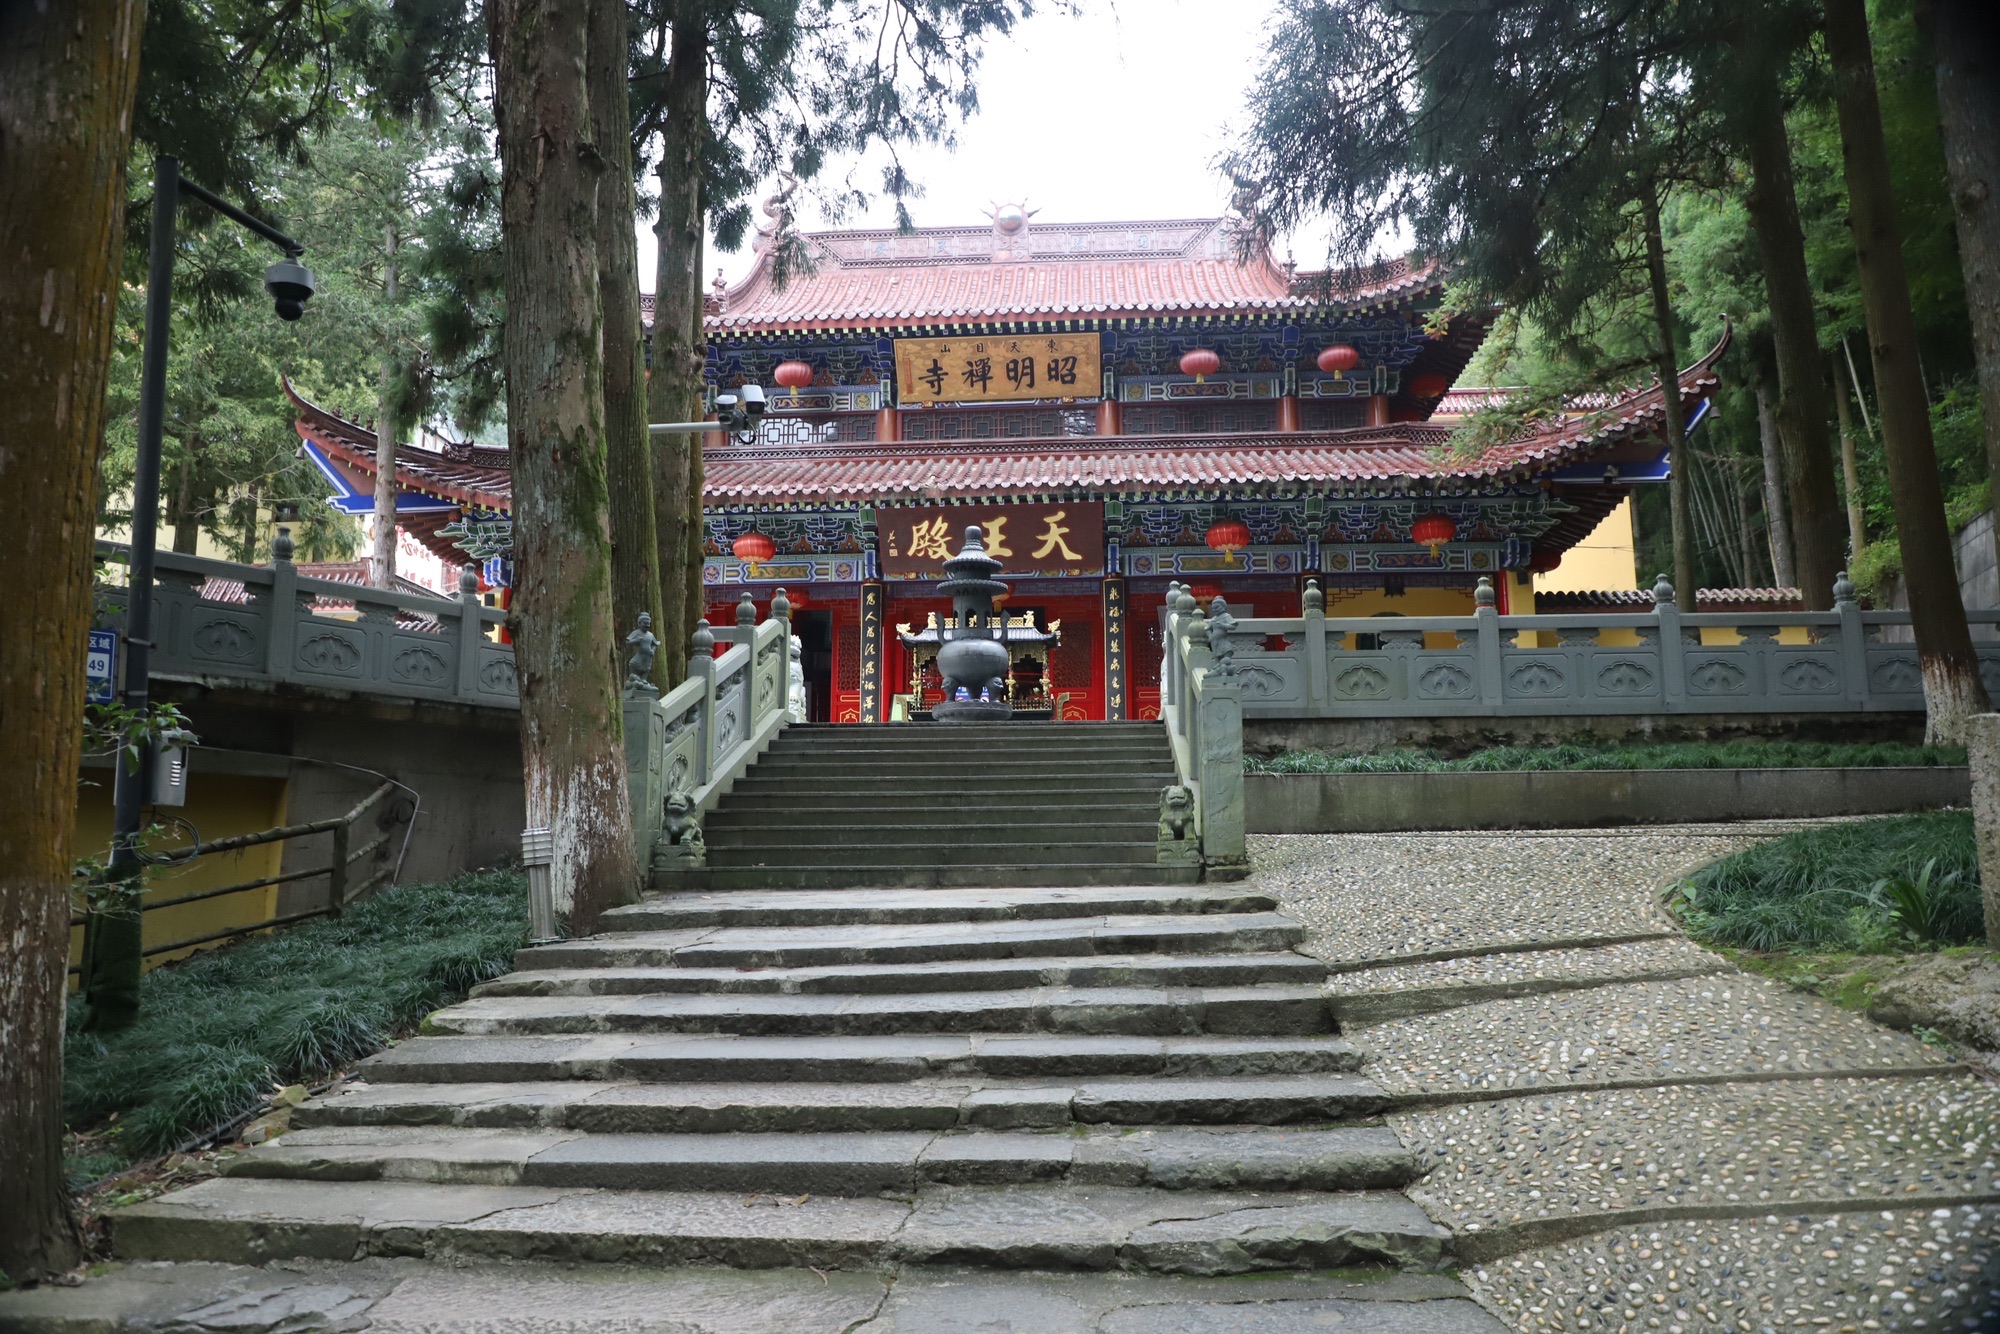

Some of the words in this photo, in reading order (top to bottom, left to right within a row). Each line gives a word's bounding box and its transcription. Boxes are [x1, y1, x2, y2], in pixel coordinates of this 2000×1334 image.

[918, 355, 1078, 396] 昭明禪寺
[907, 510, 1083, 561] 天王殿
[88, 659, 105, 672] 49
